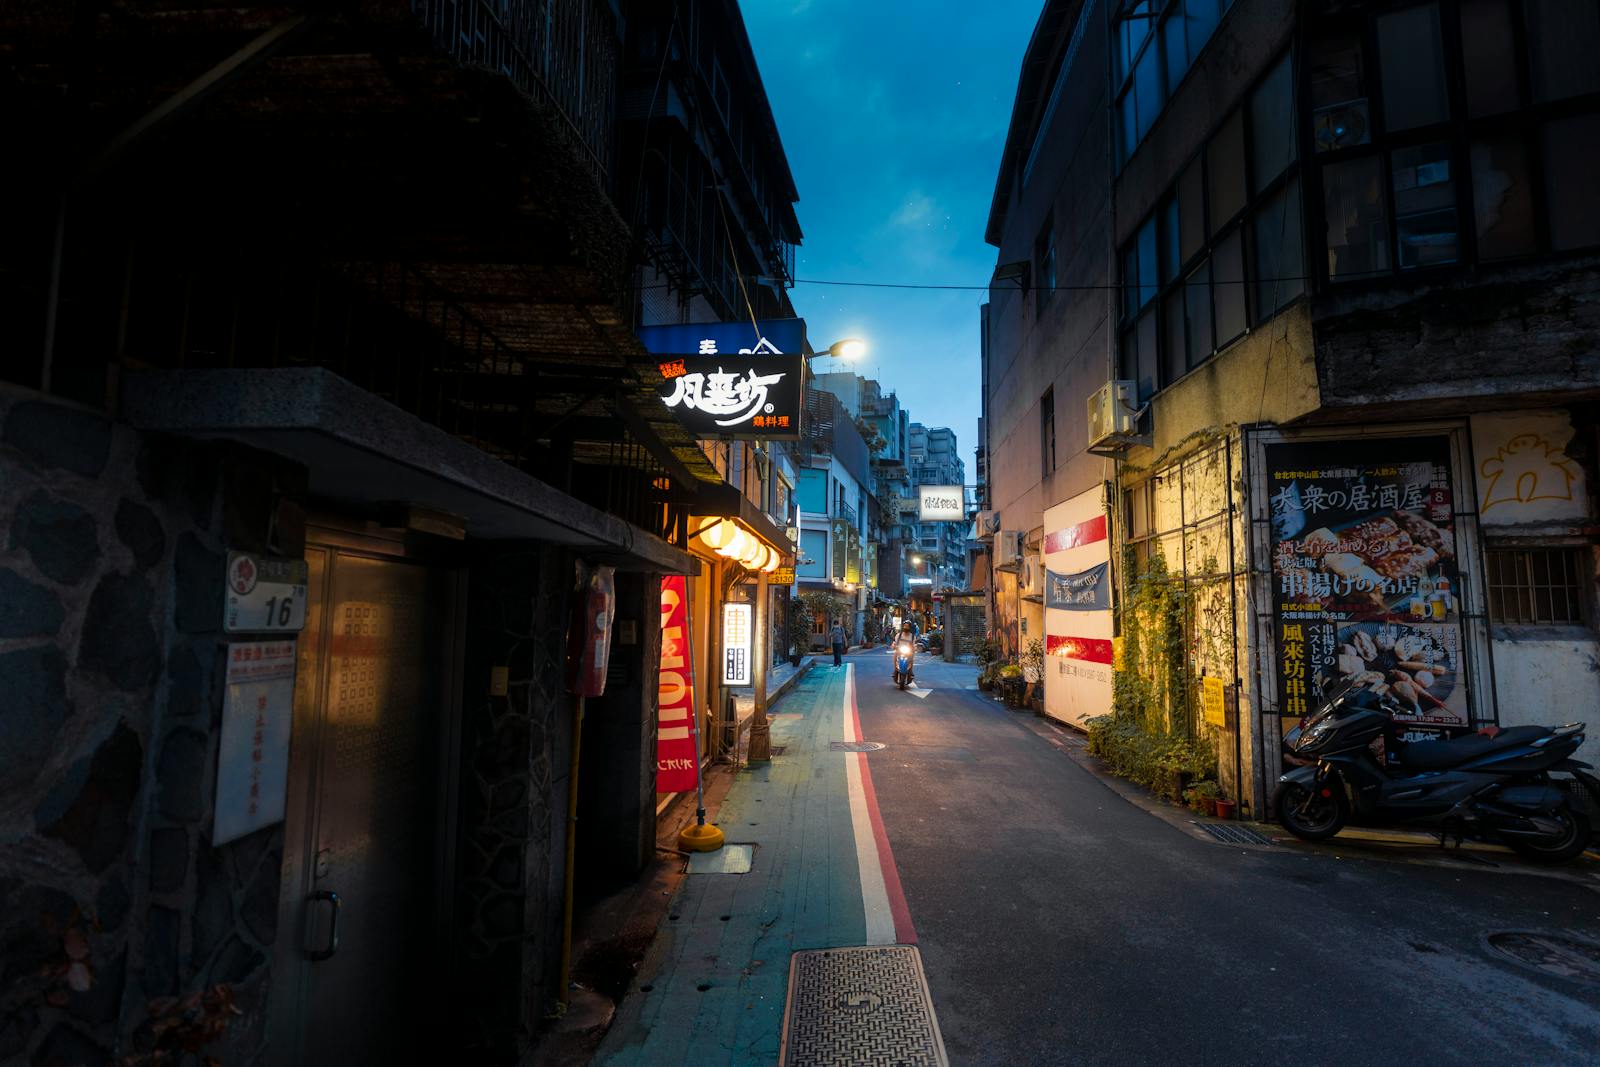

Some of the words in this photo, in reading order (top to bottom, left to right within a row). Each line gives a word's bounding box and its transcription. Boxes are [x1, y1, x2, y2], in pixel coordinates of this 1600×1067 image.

[1435, 491, 1444, 503] 8
[1281, 572, 1419, 598] 串揚げの名店
[265, 596, 293, 627] 16
